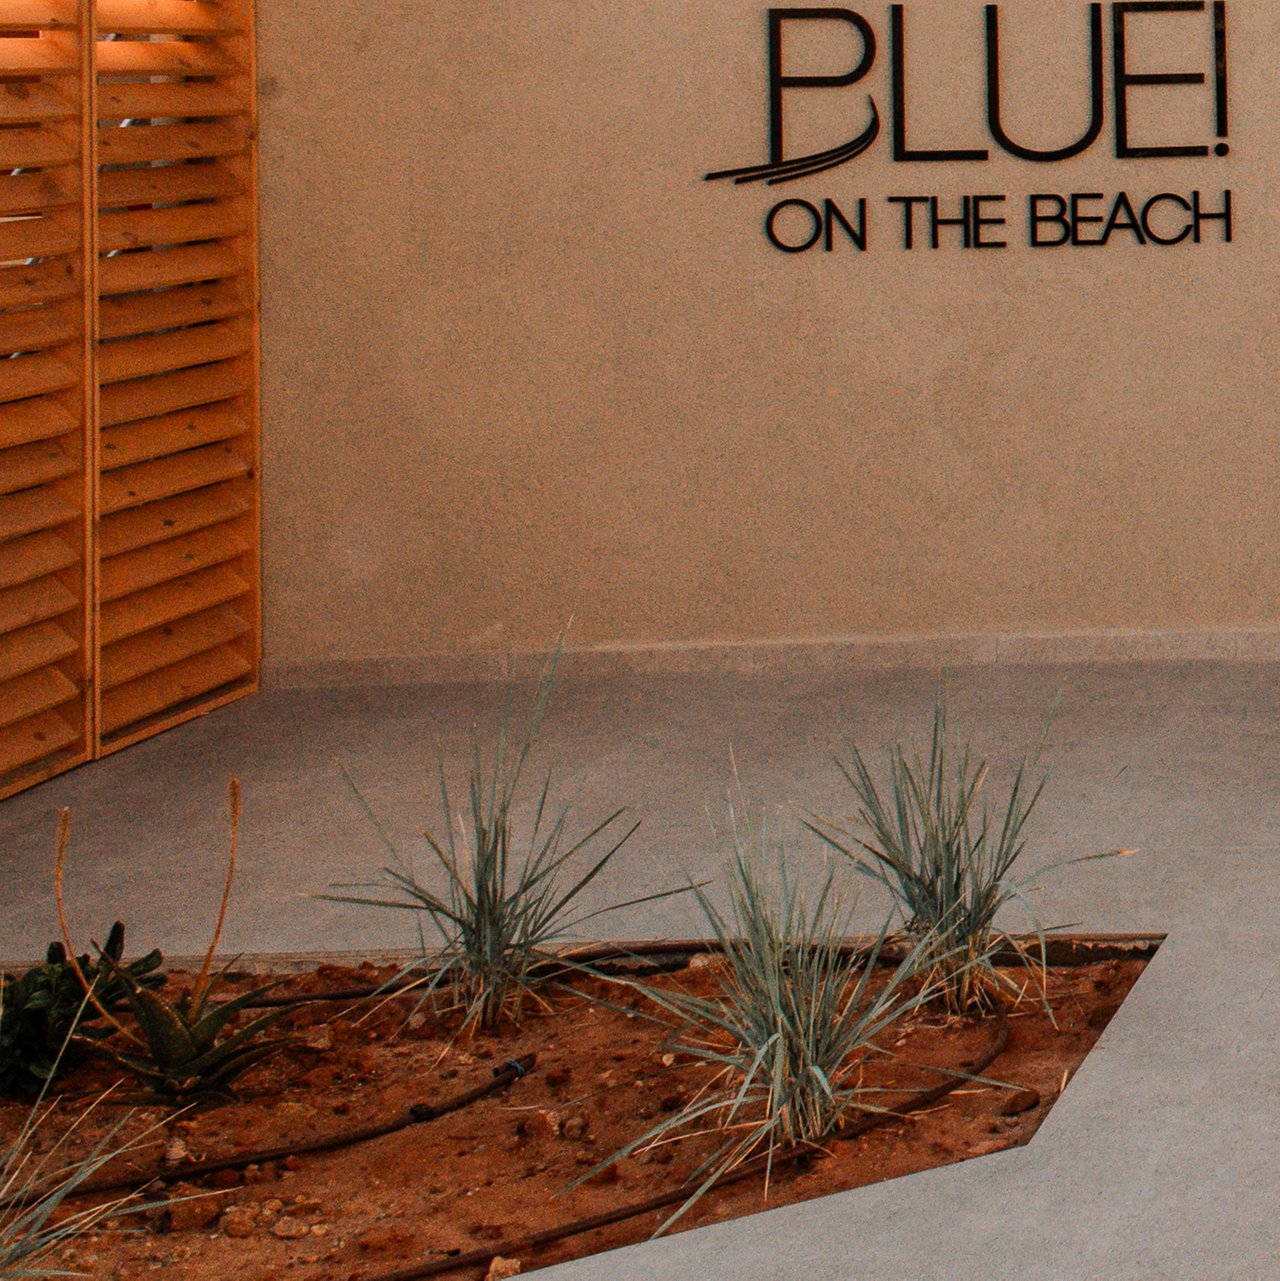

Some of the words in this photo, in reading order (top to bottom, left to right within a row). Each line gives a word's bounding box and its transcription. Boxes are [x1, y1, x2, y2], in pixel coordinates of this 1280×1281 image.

[703, 0, 1230, 186] BLUE!
[764, 197, 868, 254] ON
[887, 194, 1007, 250] THE
[1029, 189, 1233, 249] BEACH
